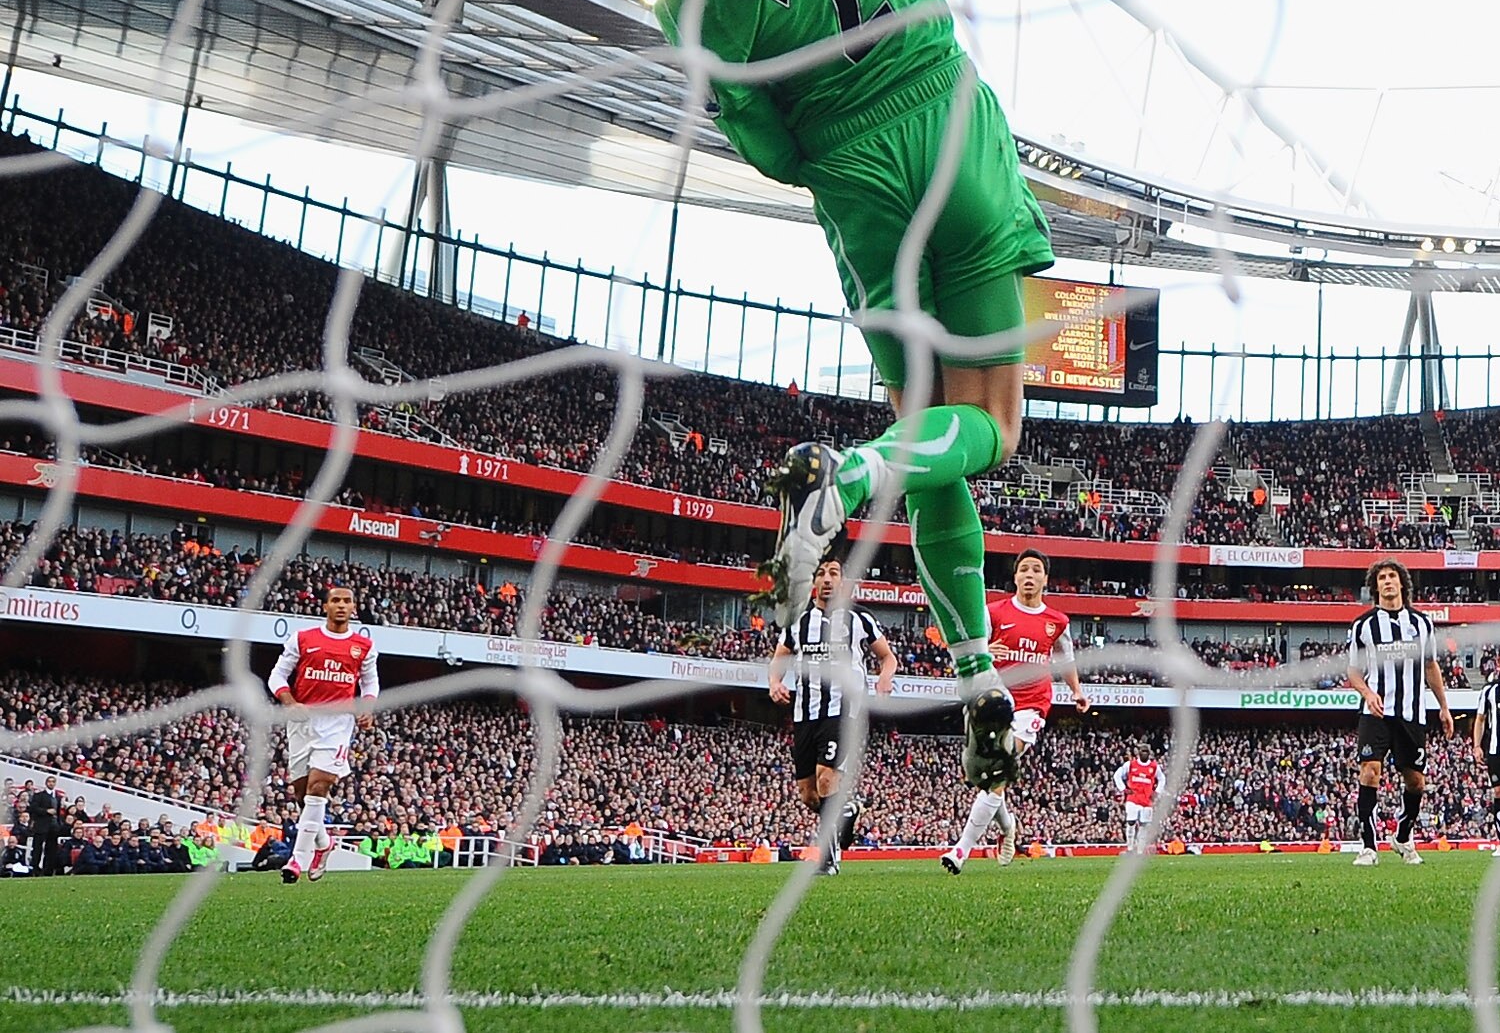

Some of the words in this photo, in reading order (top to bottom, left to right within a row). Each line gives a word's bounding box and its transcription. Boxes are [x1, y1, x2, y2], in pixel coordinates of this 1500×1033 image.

[1066, 374, 1121, 388] NEWCASTLE
[208, 406, 249, 430] 1971
[476, 458, 508, 480] 1971
[685, 500, 714, 519] 1979
[349, 512, 400, 538] Arsenal
[1227, 551, 1239, 561] EL
[1242, 551, 1287, 563] CAPITAN
[851, 584, 928, 605] Arsenal.com
[488, 639, 504, 651] Club
[554, 647, 568, 657] List
[1018, 638, 1037, 651] Fly
[1377, 641, 1418, 652] northern
[324, 659, 342, 671] Fly
[672, 661, 685, 677] Fly
[304, 667, 355, 684] Emirates
[1114, 696, 1145, 705] 5000
[1031, 718, 1041, 732] 8
[825, 741, 838, 761] 3
[1414, 747, 1425, 766] 2
